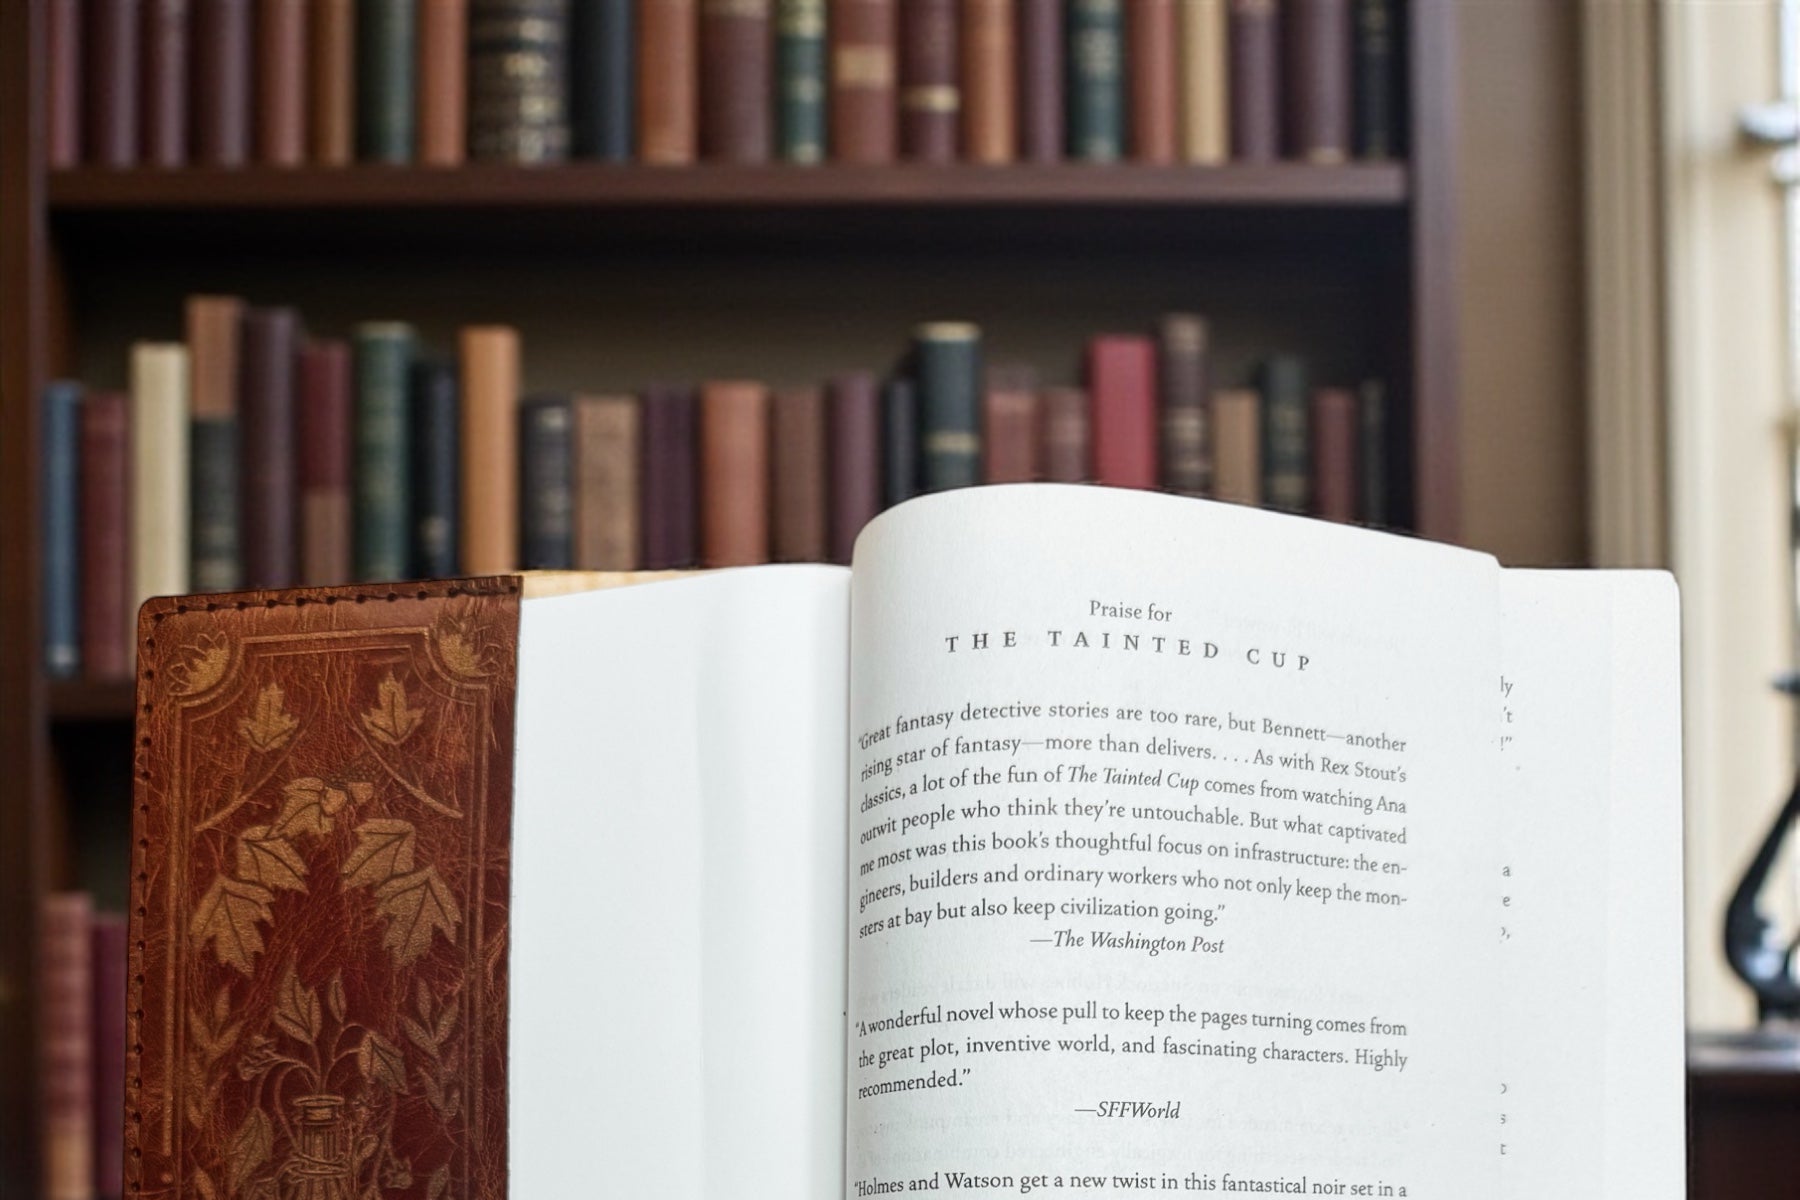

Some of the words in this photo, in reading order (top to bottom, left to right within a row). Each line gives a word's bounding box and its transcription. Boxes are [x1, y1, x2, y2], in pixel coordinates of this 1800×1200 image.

[1089, 599, 1143, 620] Praise
[1147, 602, 1173, 623] for
[944, 630, 1017, 654] THE
[1047, 630, 1219, 659] TAINTED
[1246, 648, 1310, 672] CUP
[895, 711, 955, 735] fantasy
[959, 700, 1042, 722] detective
[1048, 700, 1109, 719] stories
[1115, 708, 1143, 722] are
[1149, 708, 1179, 724] too
[1184, 713, 1223, 731] rare,
[1227, 711, 1256, 733] but
[1262, 717, 1407, 753] Bennett—another
[859, 785, 906, 815] classics,
[909, 782, 918, 796] a
[922, 773, 945, 793] lot
[949, 767, 970, 789] of
[972, 765, 1002, 786] the
[1007, 764, 1038, 784] fun
[1043, 763, 1065, 783] of
[1067, 764, 1098, 783] The
[1102, 767, 1163, 787] Tainted
[1166, 772, 1200, 797] Cup
[1203, 779, 1256, 796] comes
[1260, 778, 1298, 801] from
[1301, 787, 1374, 816] watching
[1375, 795, 1407, 814] Ana
[859, 816, 898, 846] outwit
[901, 803, 956, 836] people
[960, 799, 1001, 819] who
[1007, 796, 1058, 817] think
[1063, 796, 1126, 823] they’re
[1131, 804, 1244, 827] untouchable.
[1249, 811, 1279, 831] But
[1282, 814, 1324, 836] what
[1327, 823, 1407, 845] captivated
[858, 883, 906, 915] gineers,
[909, 867, 979, 892] builders
[983, 862, 1019, 884] and
[1023, 862, 1105, 889] ordinary
[1107, 865, 1178, 887] workers
[1181, 868, 1220, 889] who
[1223, 878, 1253, 892] not
[1255, 875, 1293, 901] only
[1295, 877, 1333, 905] keep
[1335, 882, 1362, 903] the
[1365, 891, 1408, 906] mon-
[858, 922, 885, 940] sters
[886, 914, 902, 930] at
[904, 906, 933, 929] bay
[936, 901, 967, 921] but
[970, 897, 1008, 918] also
[1012, 895, 1056, 921] keep
[1060, 896, 1160, 918] civilization
[1164, 902, 1226, 928] going.”
[1029, 928, 1085, 948] —The
[1090, 930, 1186, 957] Washington
[1190, 935, 1225, 954] Post
[867, 1004, 943, 1032] wonderful
[946, 1000, 995, 1023] novel
[997, 999, 1059, 1020] whose
[1061, 999, 1097, 1026] pull
[1101, 1006, 1121, 1021] to
[1124, 1001, 1165, 1028] keep
[1168, 1003, 1197, 1023] the
[1200, 1011, 1248, 1032] pages
[1251, 1011, 1313, 1037] turning
[1315, 1019, 1366, 1034] comes
[1369, 1016, 1408, 1037] from
[858, 1048, 876, 1069] the
[878, 1045, 915, 1070] great
[919, 1037, 960, 1064] plot,
[966, 1034, 1051, 1054] inventive
[1056, 1033, 1116, 1056] world,
[1121, 1034, 1156, 1054] and
[1162, 1035, 1258, 1065] fascinating
[1262, 1040, 1349, 1064] characters.
[1354, 1048, 1409, 1073] Highly
[857, 1067, 971, 1101] recommended.”
[1073, 1100, 1182, 1120] —SFFWorld
[908, 1171, 940, 1192] and
[943, 1171, 1015, 1190] Watson
[1019, 1174, 1049, 1195] get
[1053, 1175, 1065, 1188] a
[1069, 1175, 1108, 1189] new
[1111, 1171, 1157, 1190] twist
[1160, 1172, 1179, 1190] in
[1183, 1171, 1217, 1192] this
[1221, 1172, 1307, 1195] fantastical
[1312, 1178, 1347, 1196] noir
[1350, 1183, 1374, 1197] set
[1377, 1180, 1394, 1198] in
[1398, 1185, 1408, 1198] a
